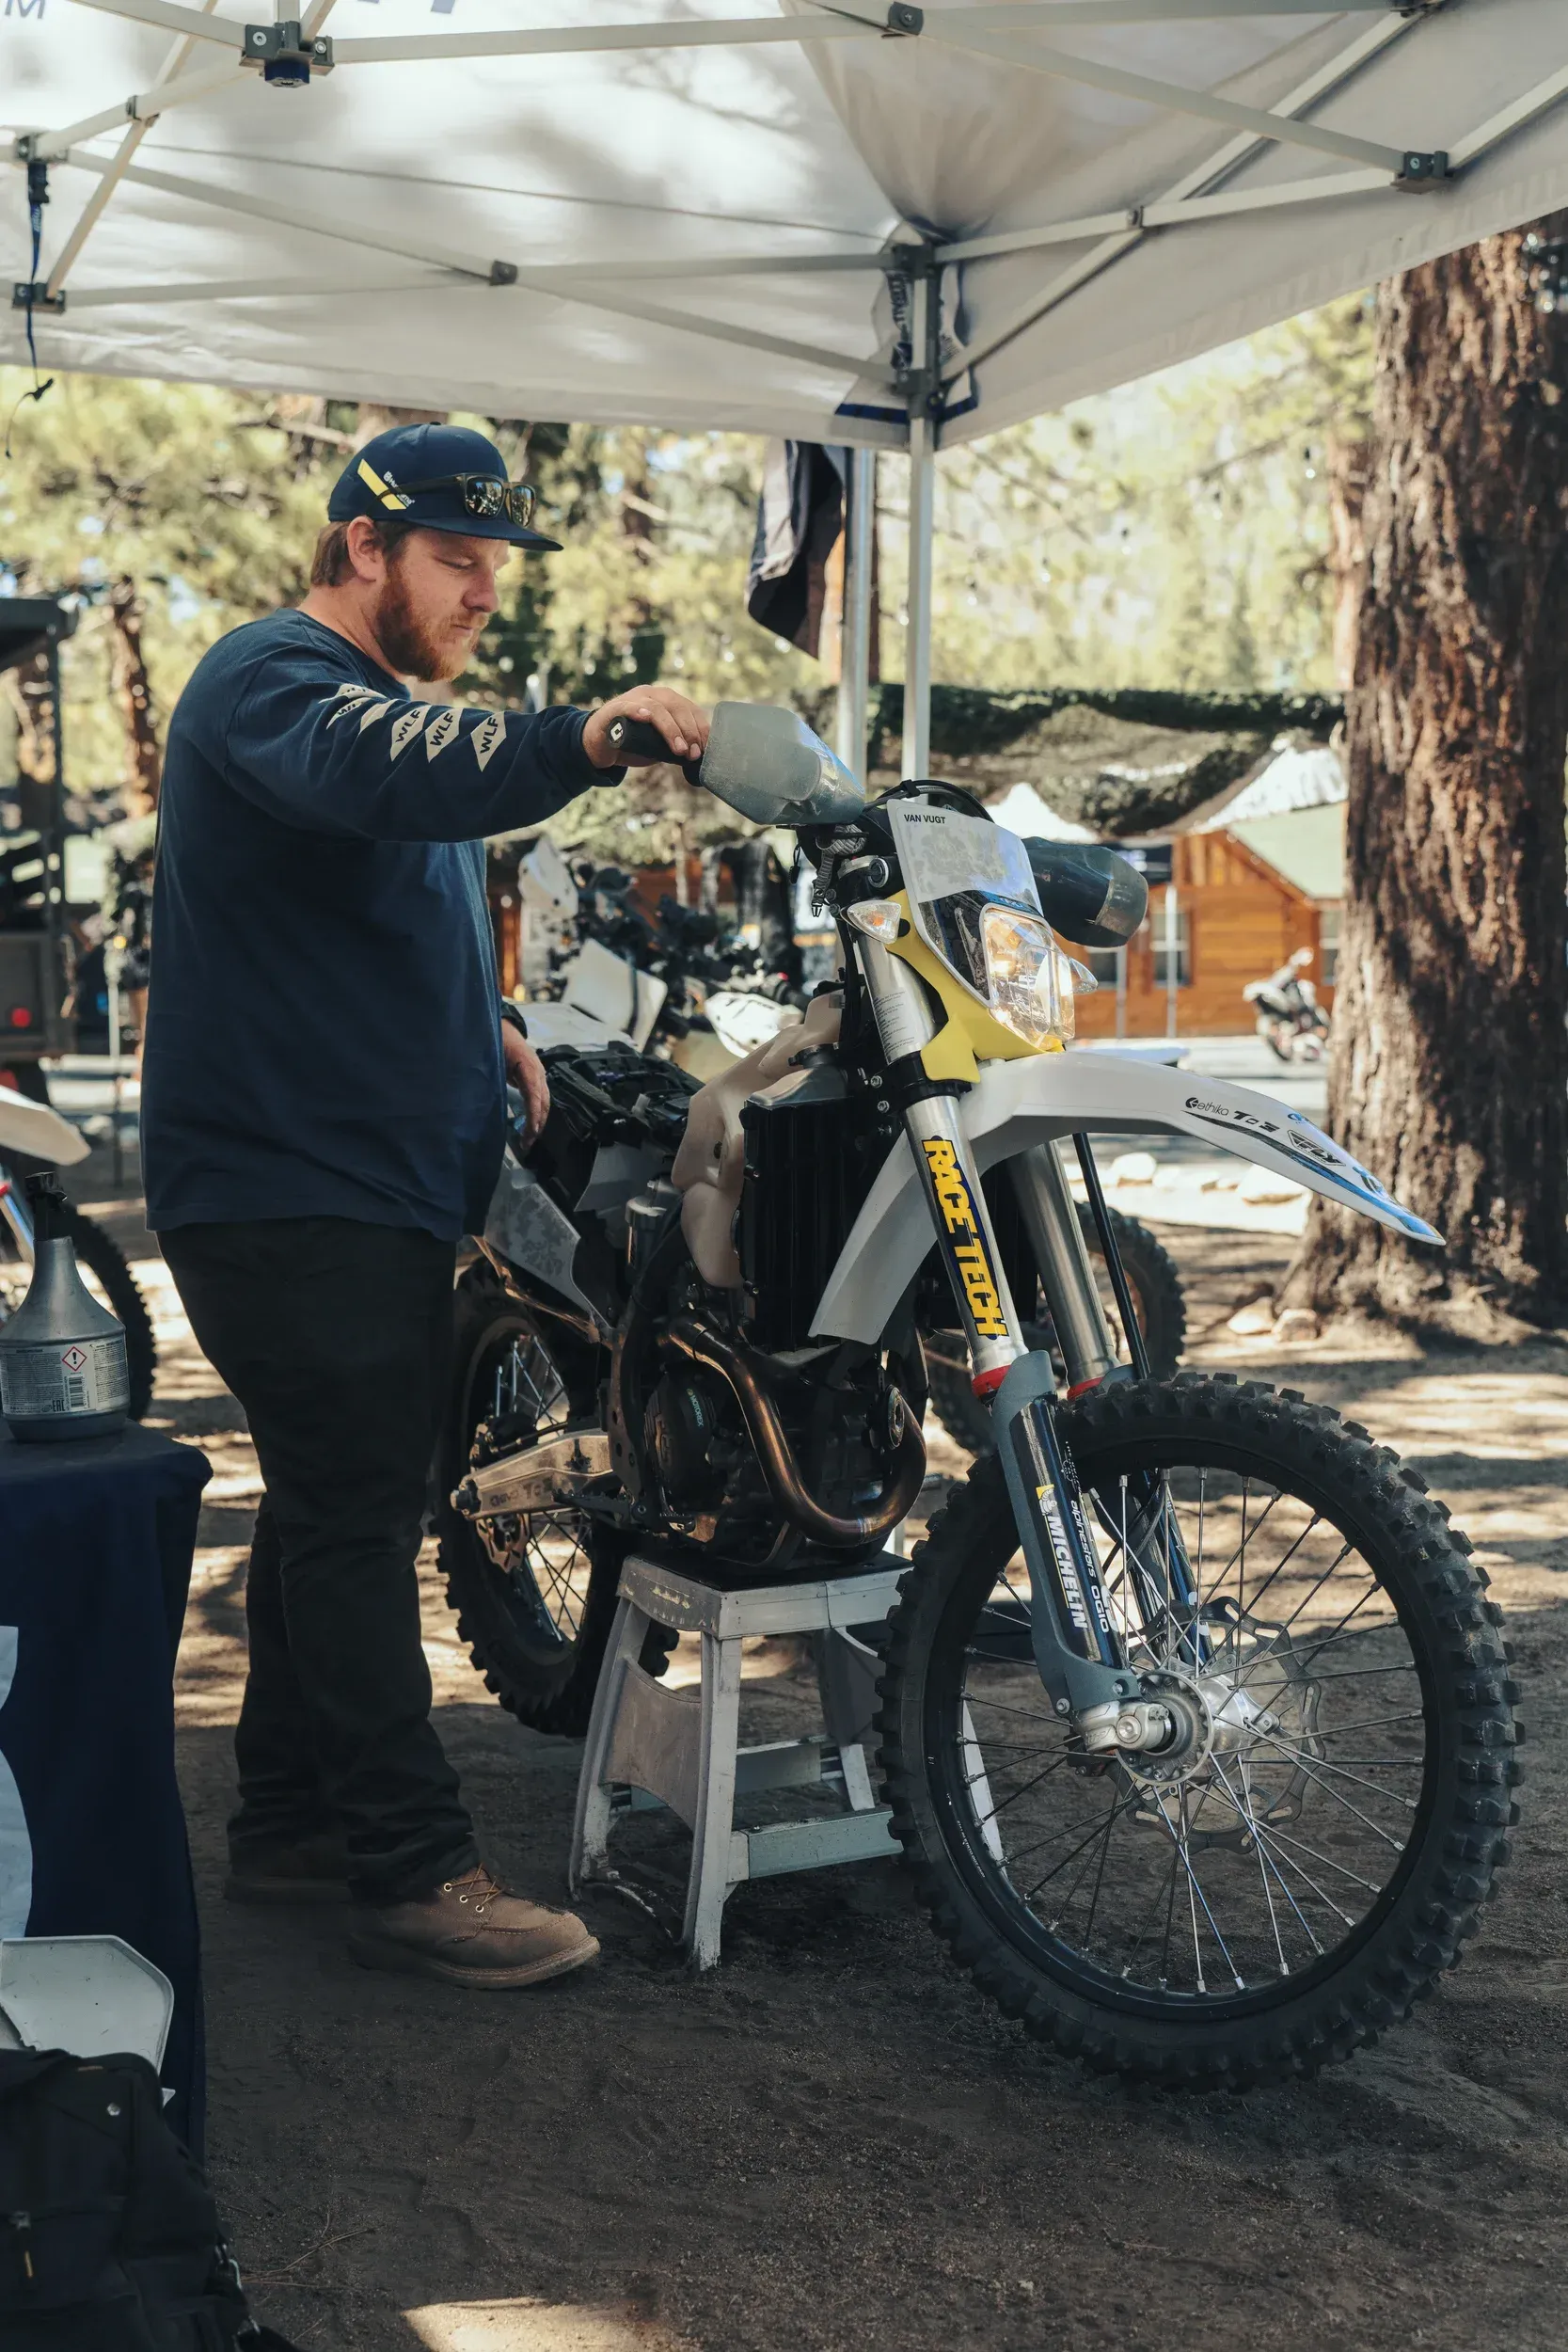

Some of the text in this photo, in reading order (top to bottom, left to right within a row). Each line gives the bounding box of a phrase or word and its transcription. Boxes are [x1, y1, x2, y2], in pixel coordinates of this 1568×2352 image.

[394, 708, 421, 743] WLF
[429, 711, 455, 746] WLF
[479, 716, 499, 755] WLF
[904, 814, 946, 824] VAN VUGT
[1197, 1099, 1228, 1117] ethika
[1291, 1134, 1343, 1166] FLY
[921, 1139, 1009, 1337] RACE TECH
[690, 1394, 704, 1427] MOTOREX
[1048, 1515, 1088, 1629] MICHELIN
[1070, 1499, 1096, 1579] alpinestars
[1091, 1584, 1110, 1633] OGIO
